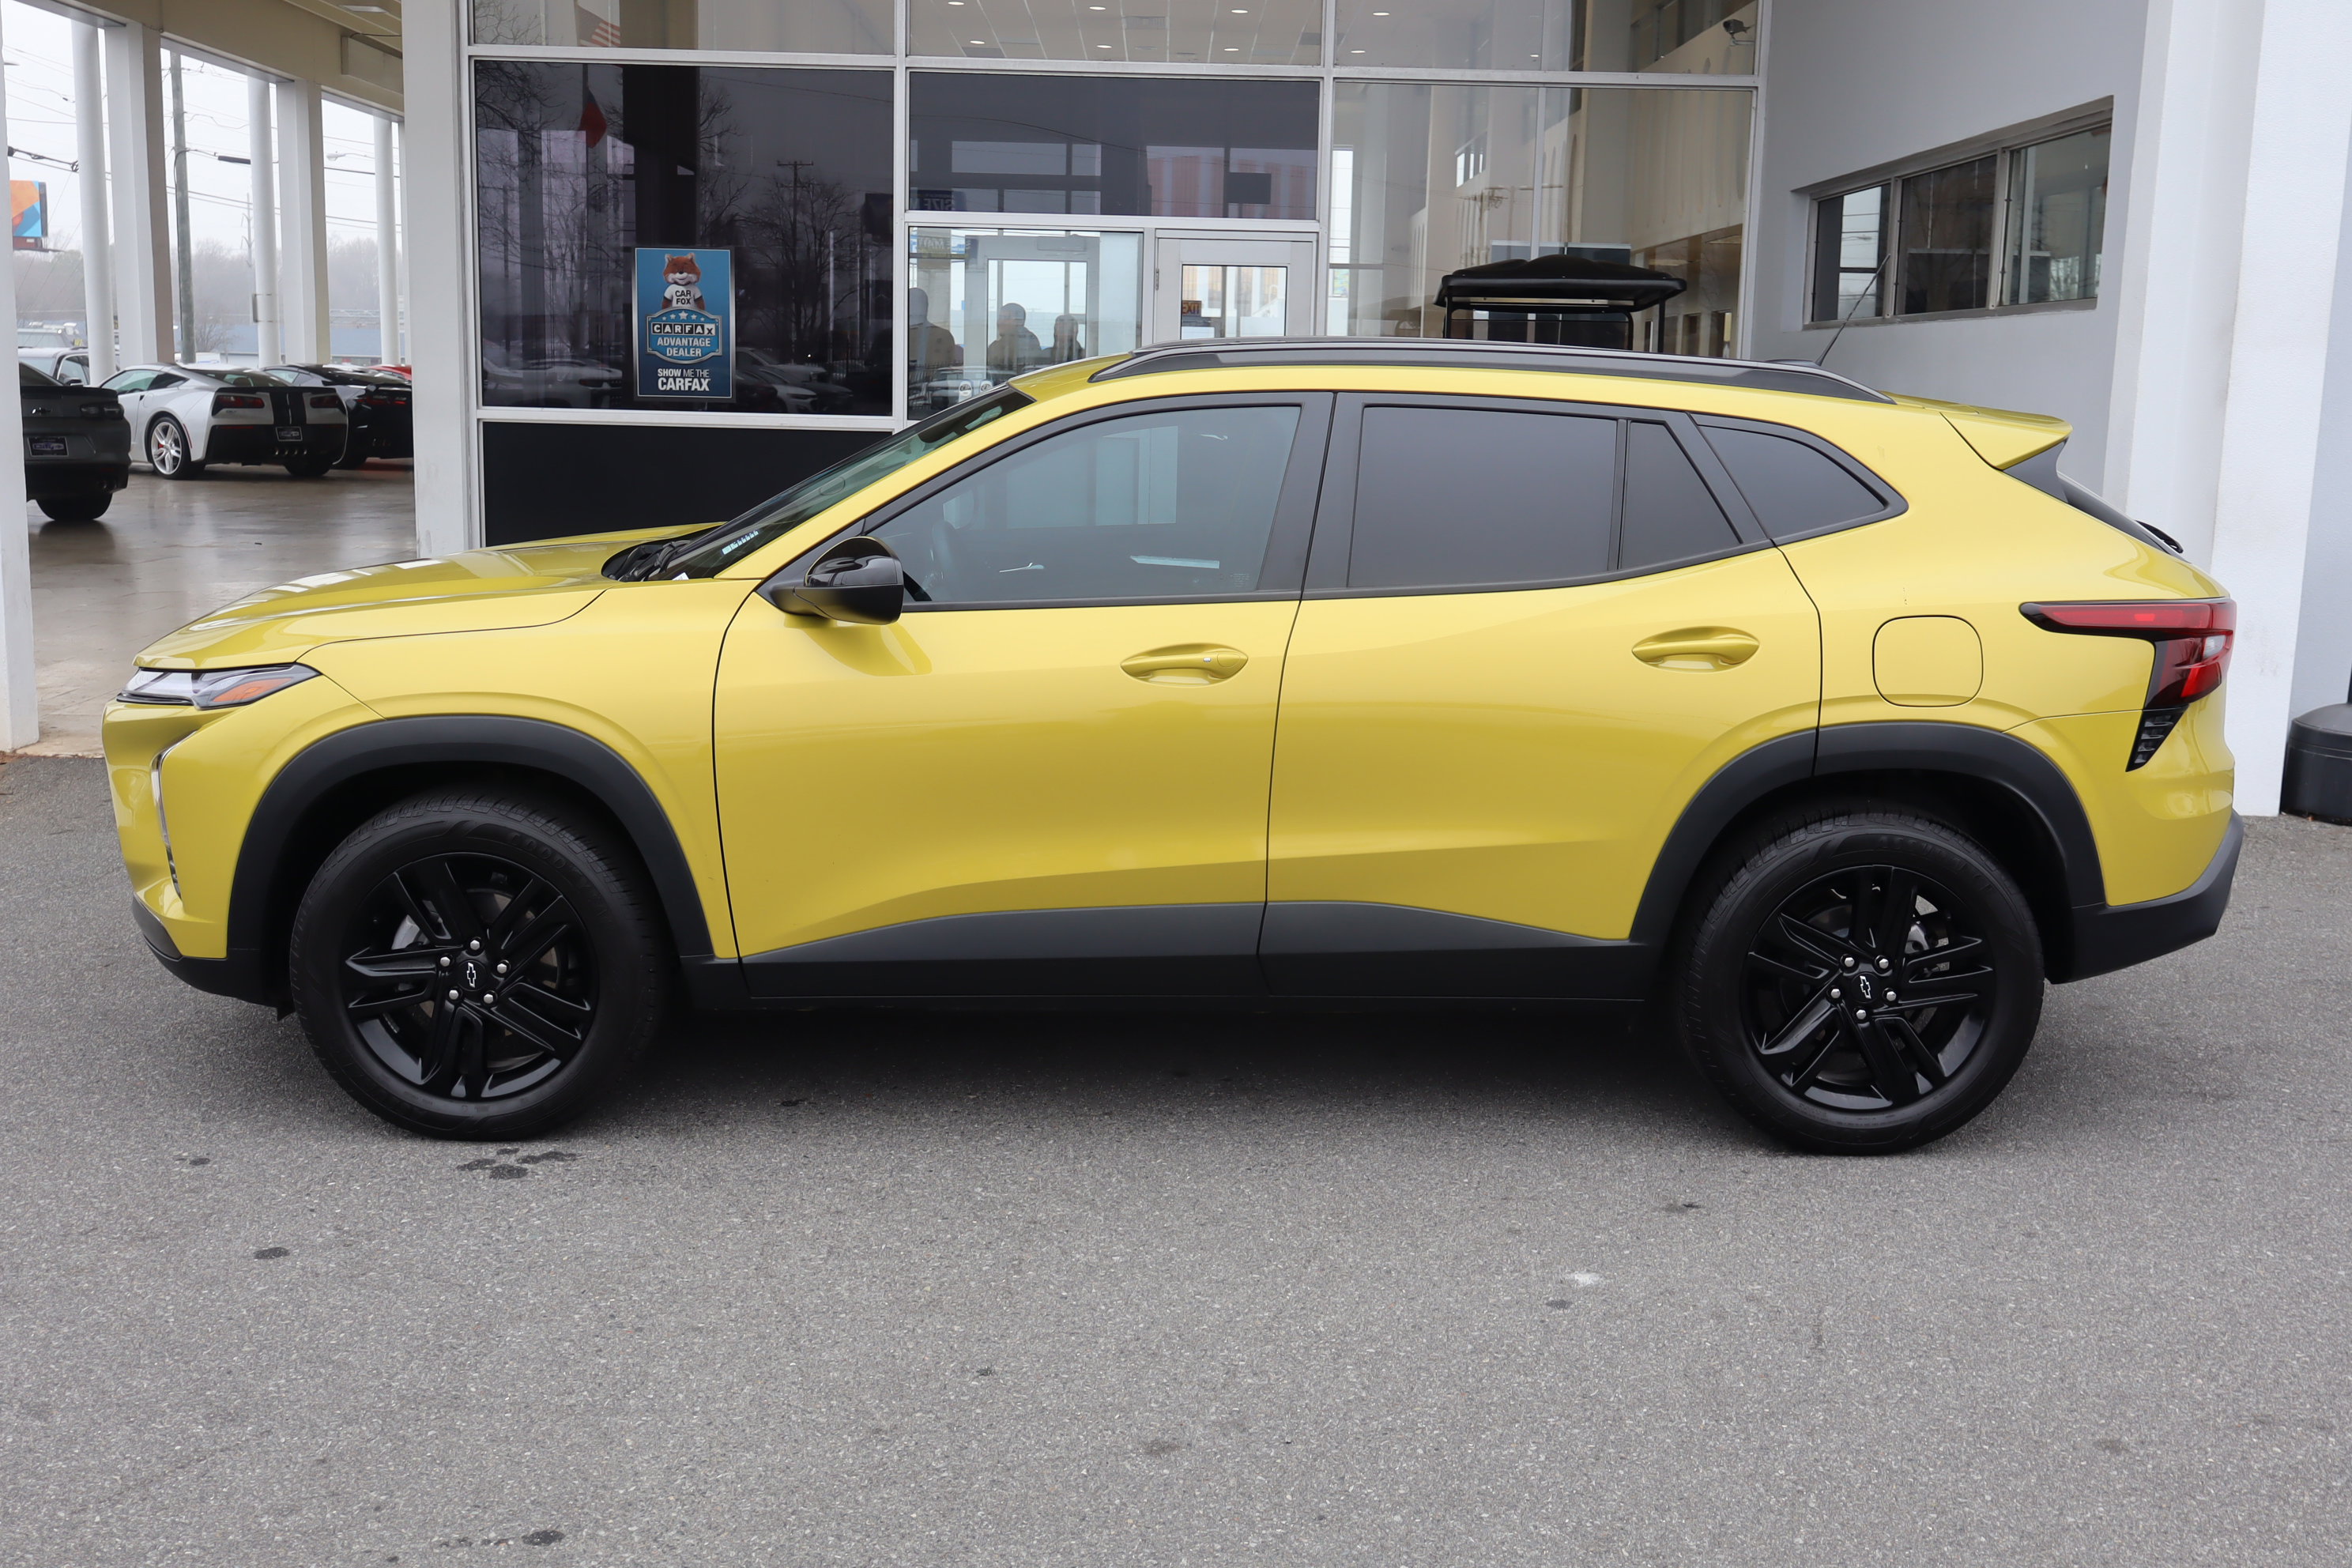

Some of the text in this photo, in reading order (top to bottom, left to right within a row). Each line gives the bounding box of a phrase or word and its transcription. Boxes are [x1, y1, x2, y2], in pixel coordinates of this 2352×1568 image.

[653, 324, 714, 335] CARFAX
[657, 337, 711, 347] ADVANTAGE
[666, 347, 702, 356] DEALER
[658, 368, 710, 378] SHOW ME THE
[658, 377, 710, 391] CARFAX
